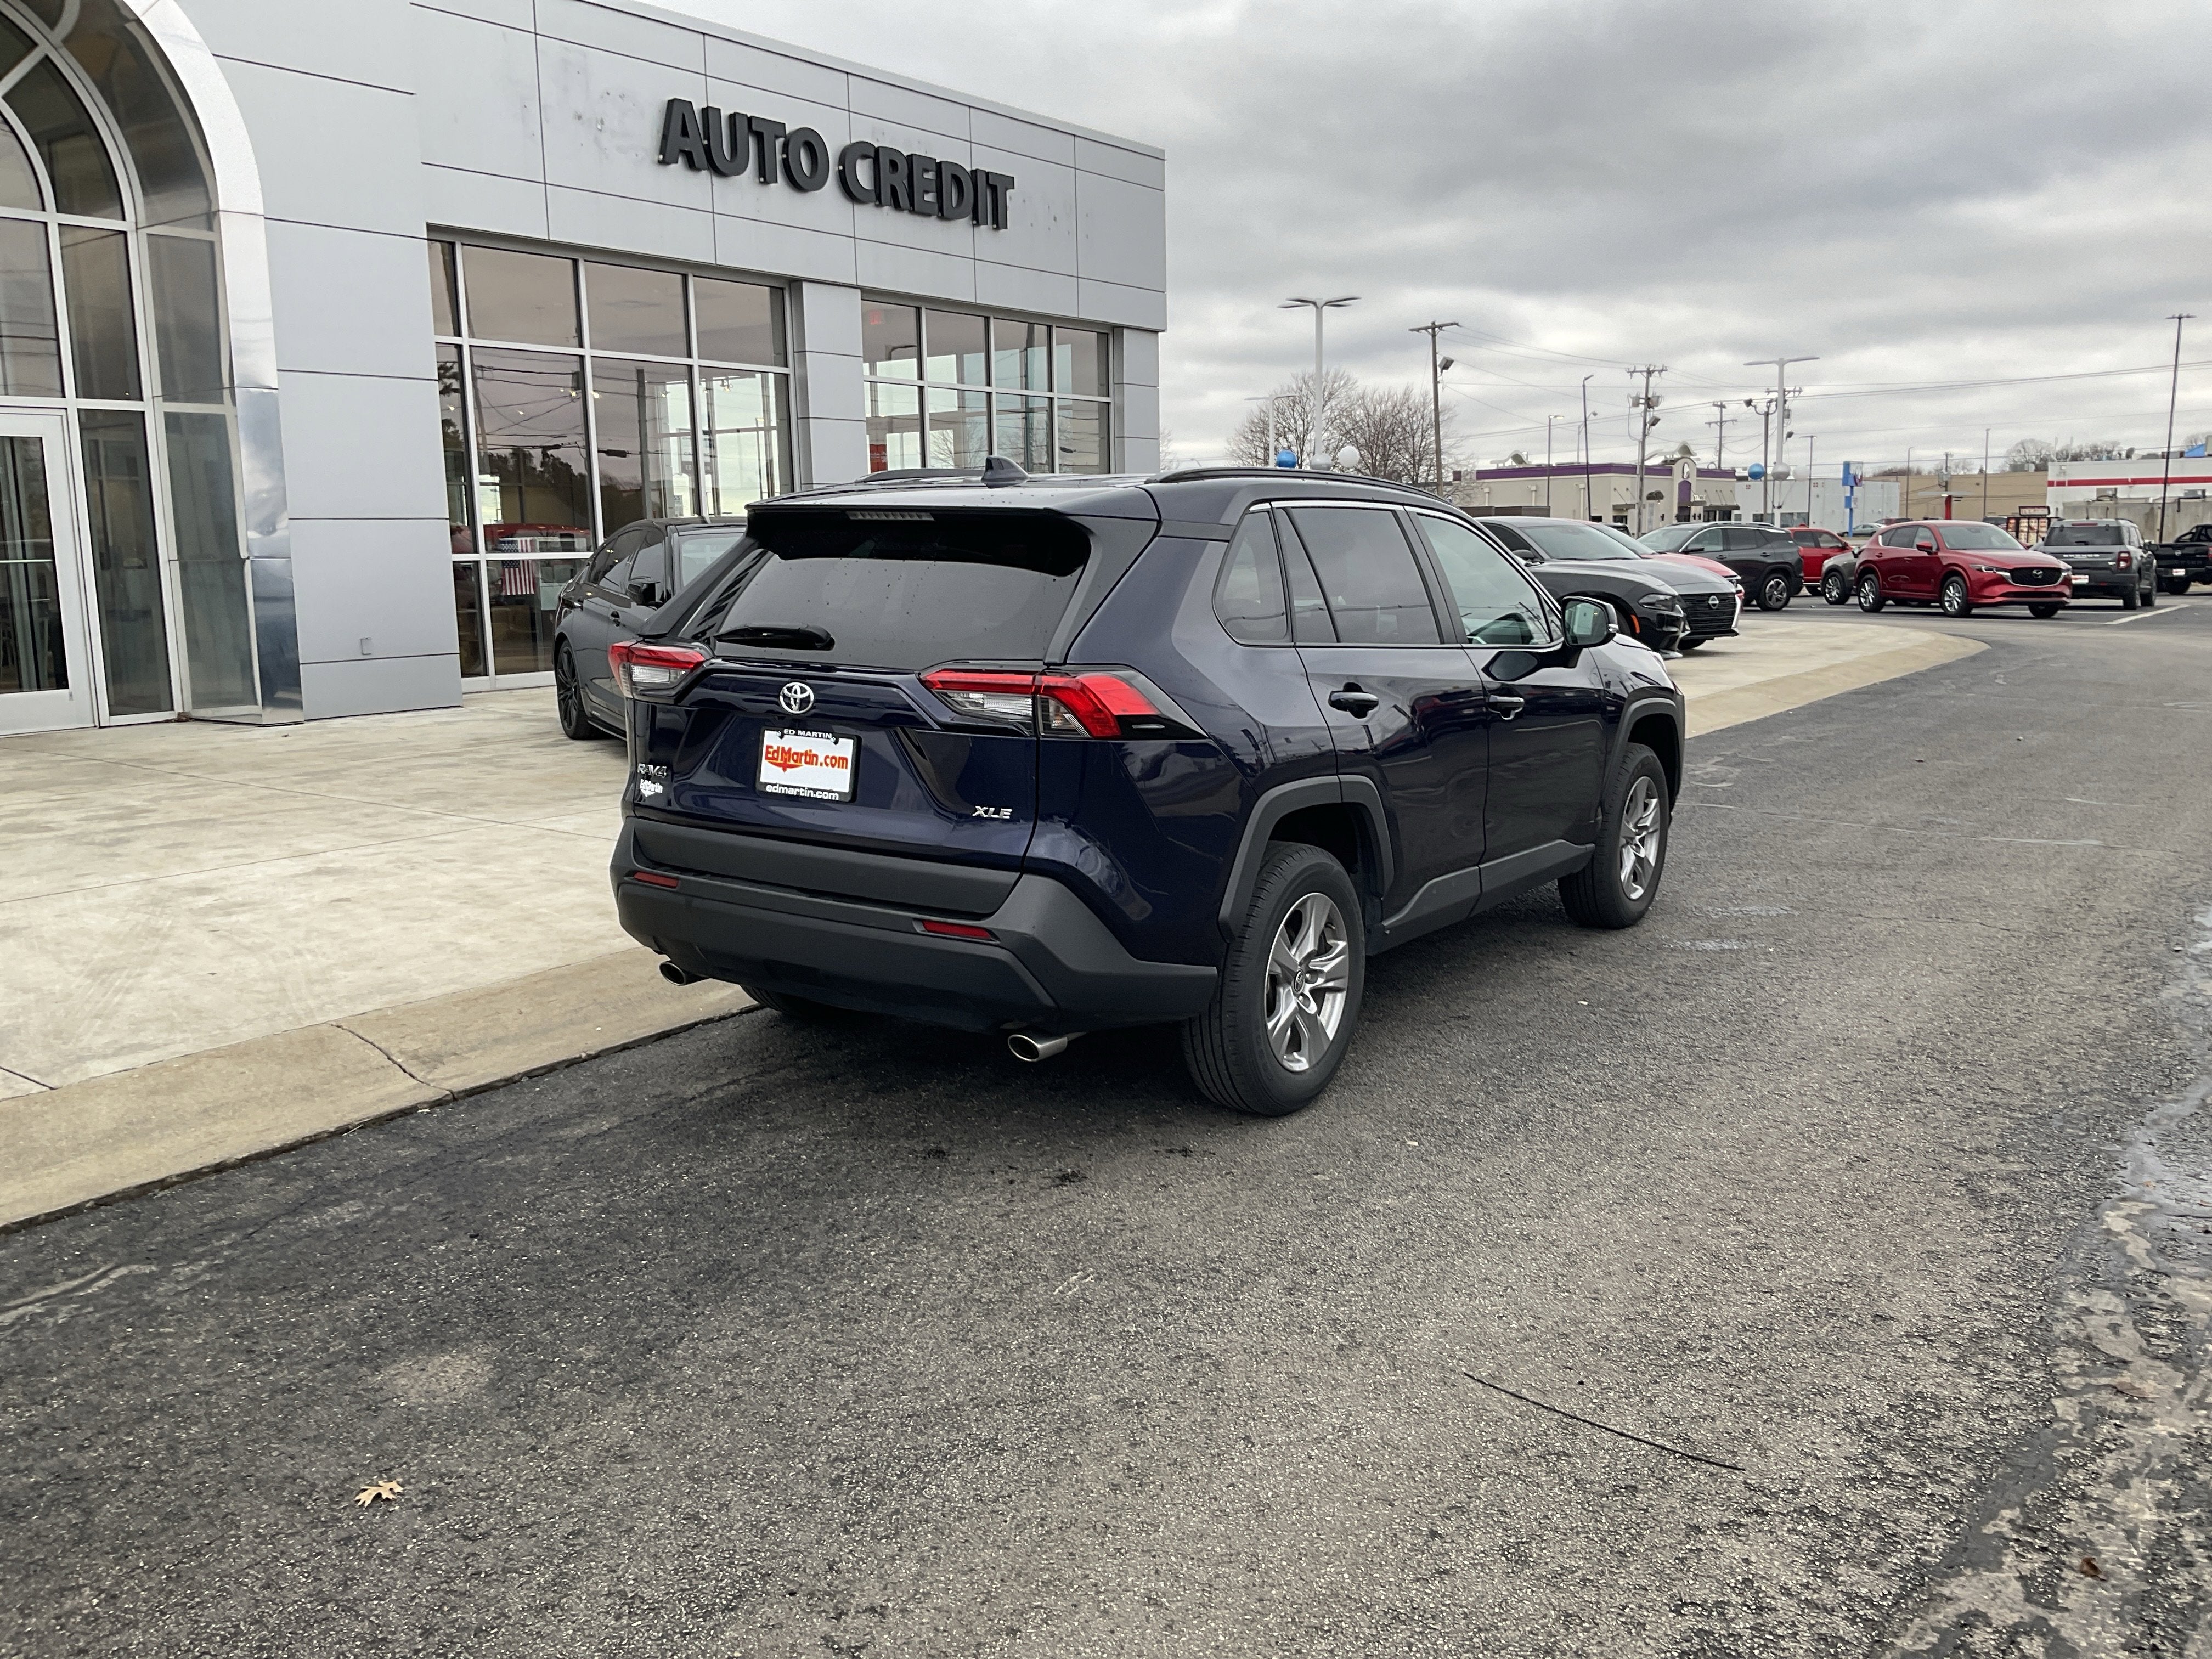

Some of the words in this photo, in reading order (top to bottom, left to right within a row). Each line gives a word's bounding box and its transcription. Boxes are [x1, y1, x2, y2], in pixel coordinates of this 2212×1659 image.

[658, 98, 830, 193] AUTO
[838, 140, 1015, 230] CREDIT
[797, 730, 832, 739] MARTIN
[637, 763, 668, 778] RAV4
[766, 783, 839, 800] edmartin.com
[972, 806, 1013, 819] XLE
